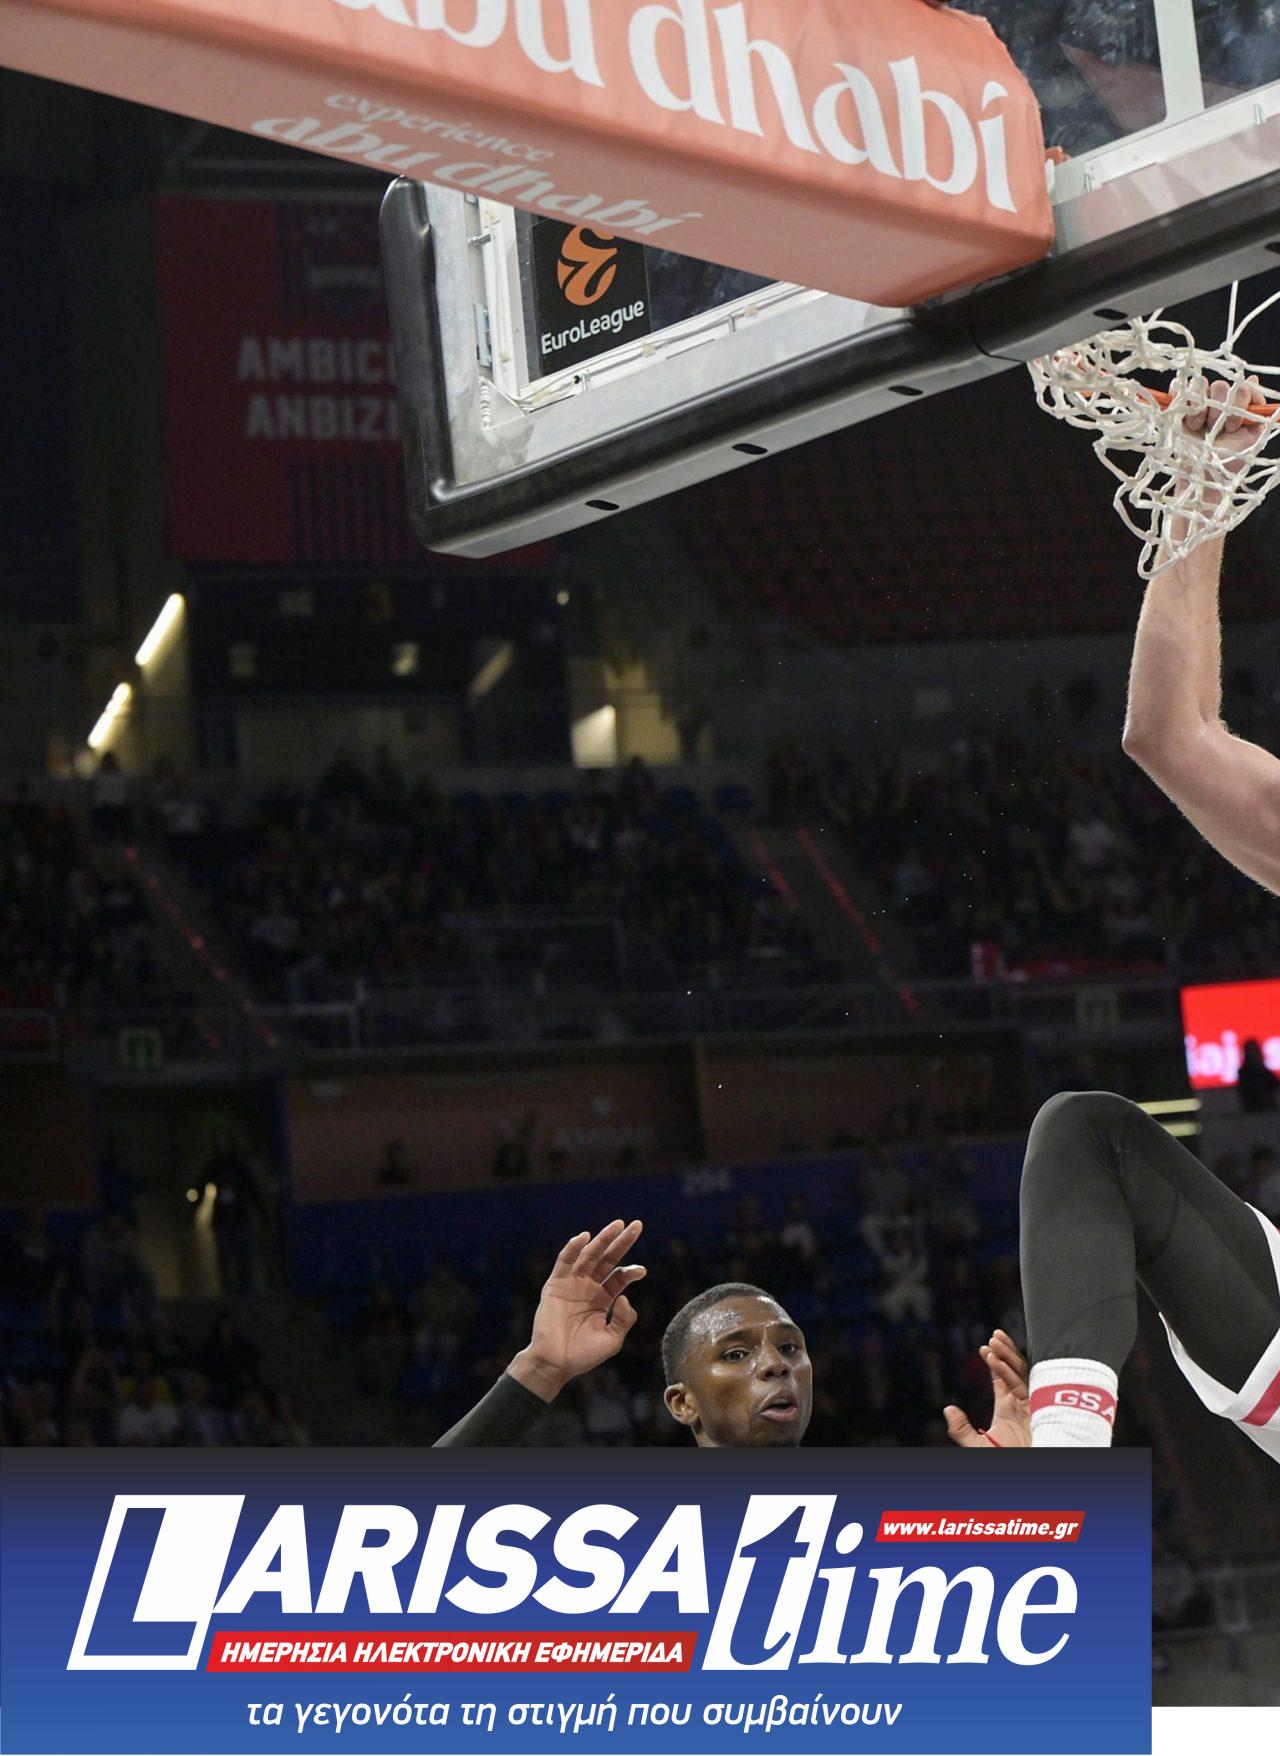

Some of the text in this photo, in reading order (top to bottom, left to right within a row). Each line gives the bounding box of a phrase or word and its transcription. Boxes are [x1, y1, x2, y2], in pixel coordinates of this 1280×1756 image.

[325, 93, 555, 163] experience
[628, 0, 1018, 214] dhabi
[250, 117, 703, 236] abu dhabi
[541, 299, 645, 355] EuroLeague
